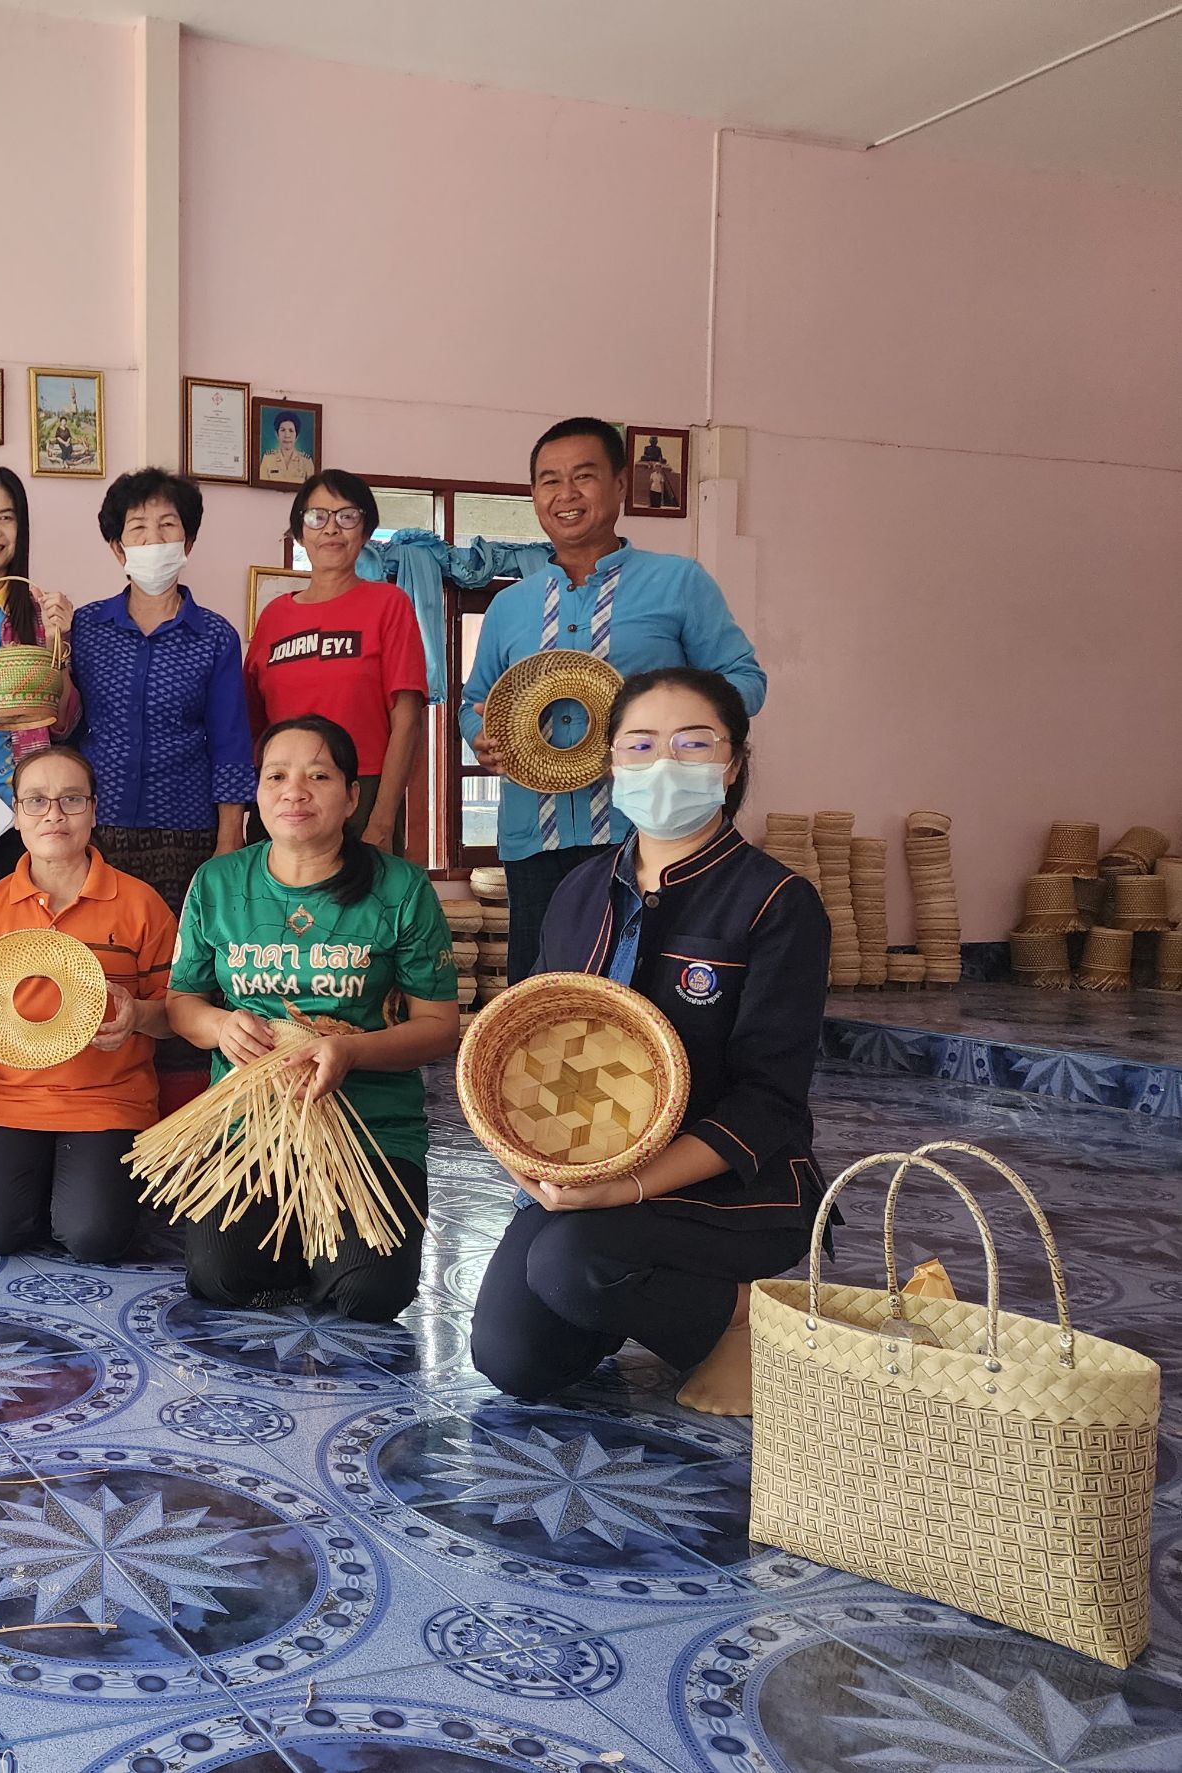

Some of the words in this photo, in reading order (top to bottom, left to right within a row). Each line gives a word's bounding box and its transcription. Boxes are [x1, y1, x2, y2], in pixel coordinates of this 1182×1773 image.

[228, 941, 301, 970] นาคา
[310, 942, 371, 970] แลน
[231, 972, 301, 998] NAKA
[311, 974, 367, 998] RUN
